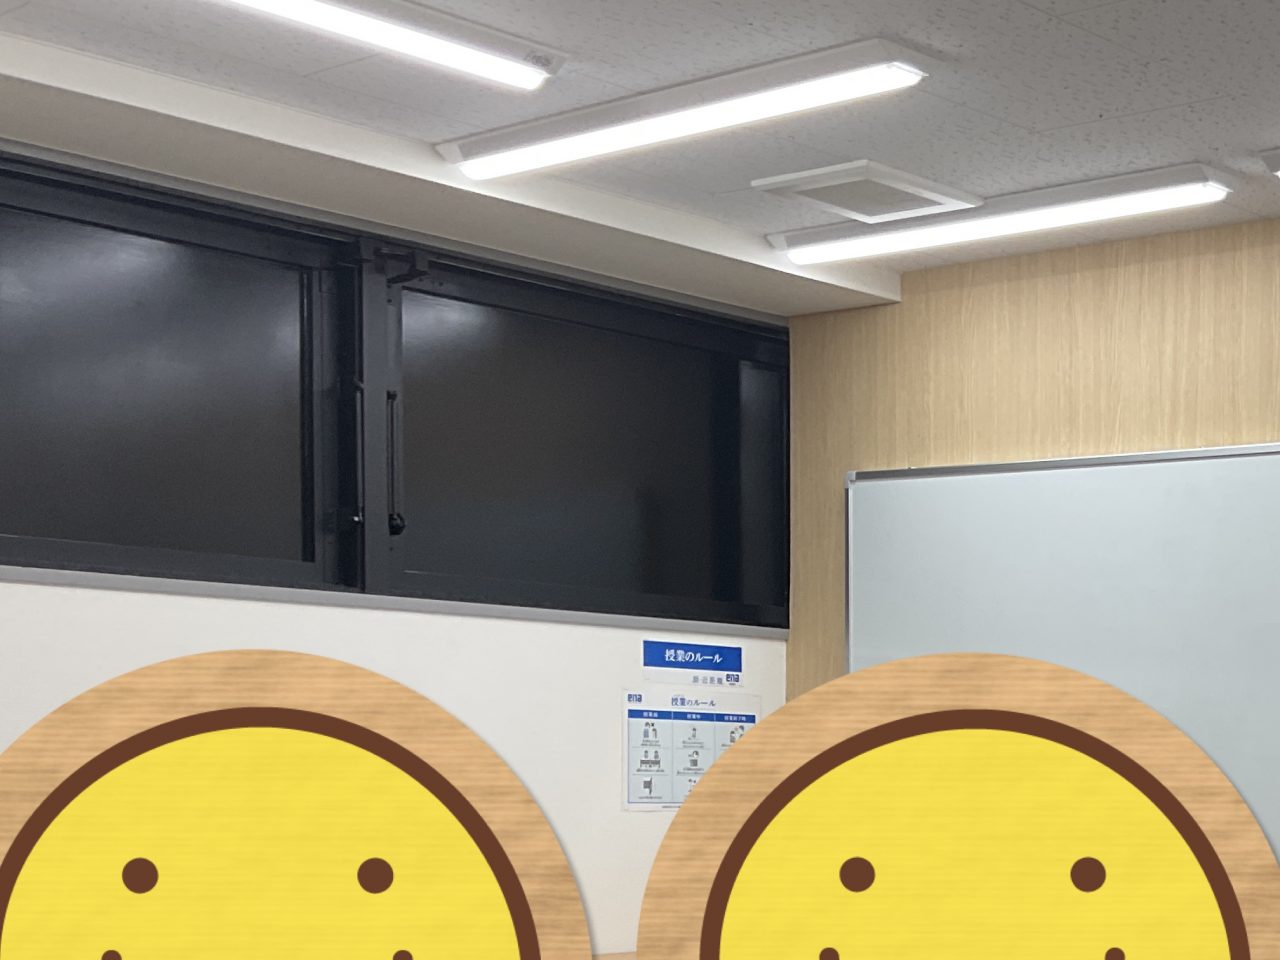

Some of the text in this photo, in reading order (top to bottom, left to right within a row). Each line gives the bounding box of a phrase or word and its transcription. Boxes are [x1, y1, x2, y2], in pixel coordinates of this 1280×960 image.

[664, 648, 723, 663] 授業のルール
[725, 673, 739, 683] ena
[627, 693, 642, 703] ena
[671, 696, 716, 707] 授業のルール
